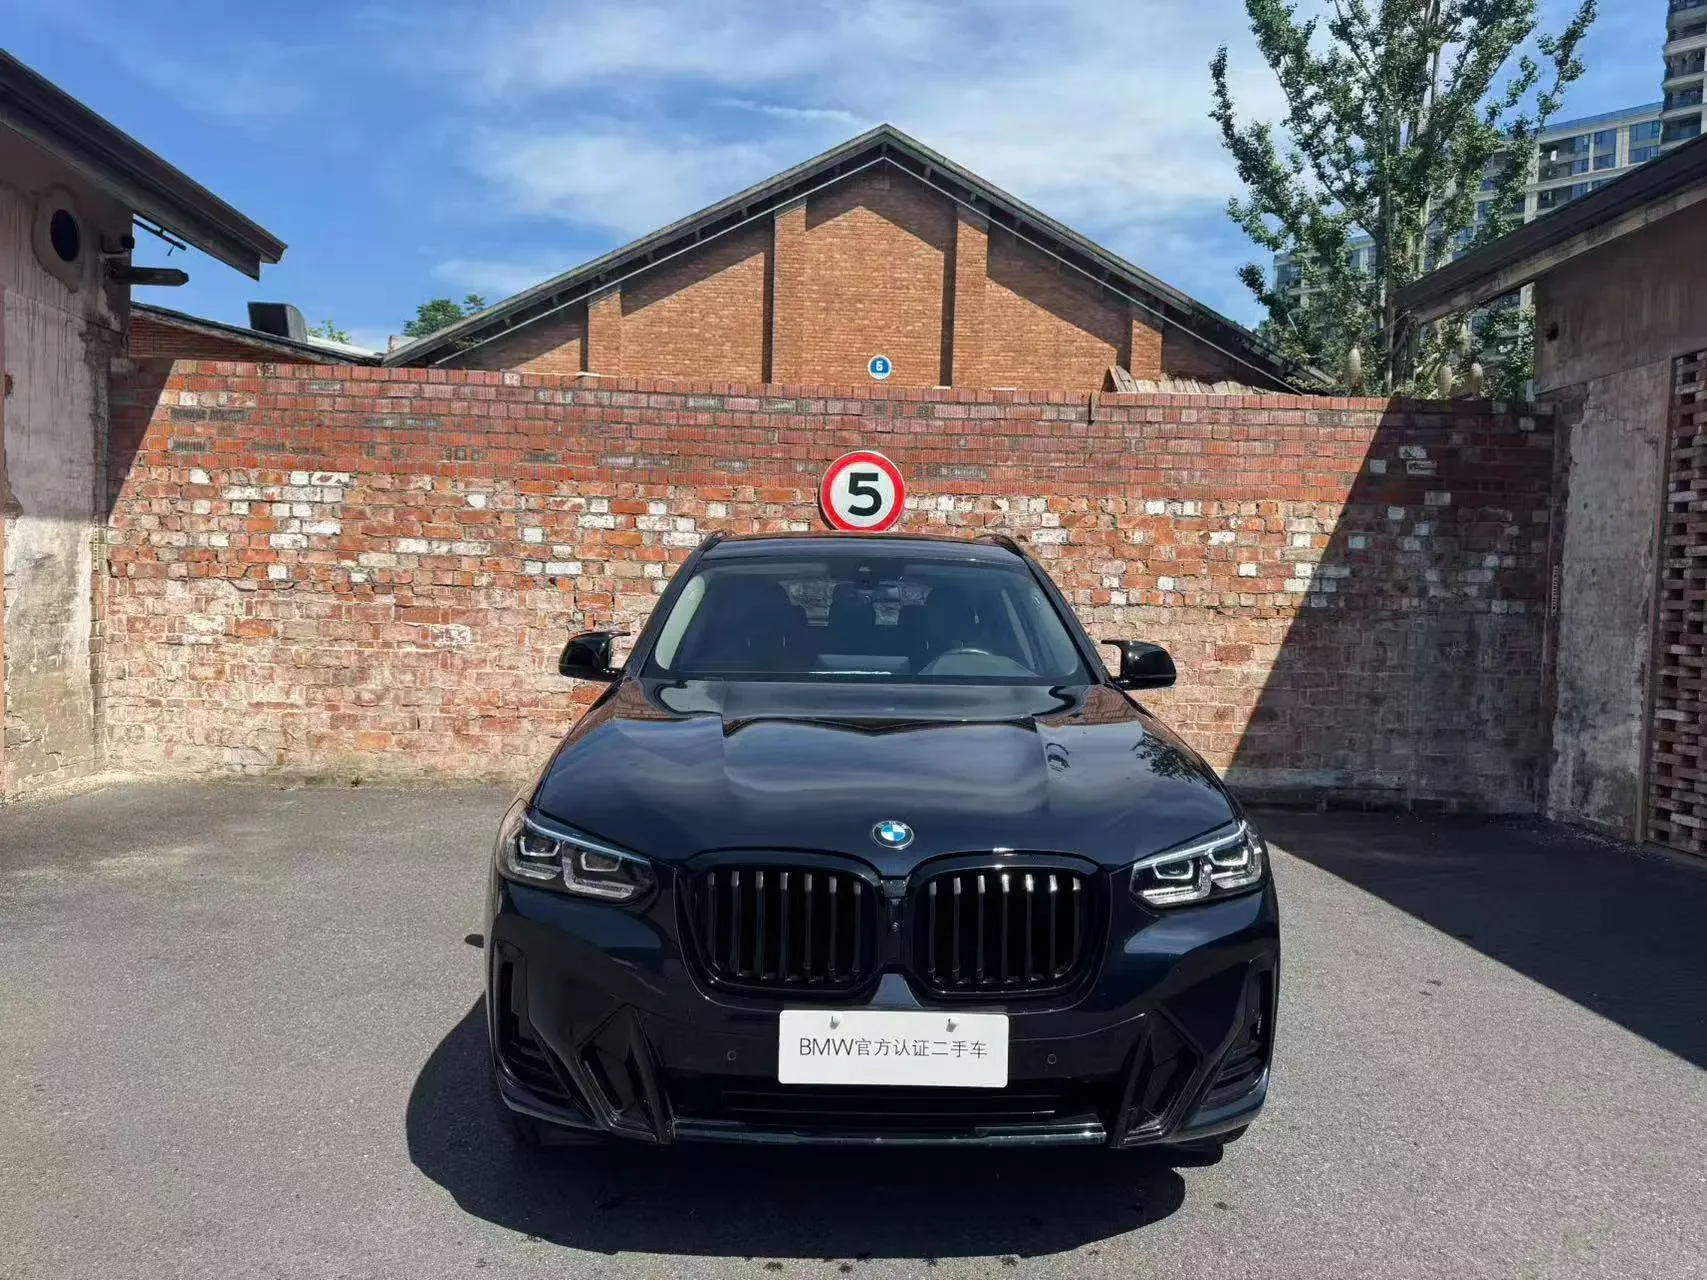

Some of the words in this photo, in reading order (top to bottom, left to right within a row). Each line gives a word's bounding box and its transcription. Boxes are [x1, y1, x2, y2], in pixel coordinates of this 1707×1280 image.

[847, 472, 882, 517] 5
[799, 1037, 988, 1059] BMW官方认证二手车
